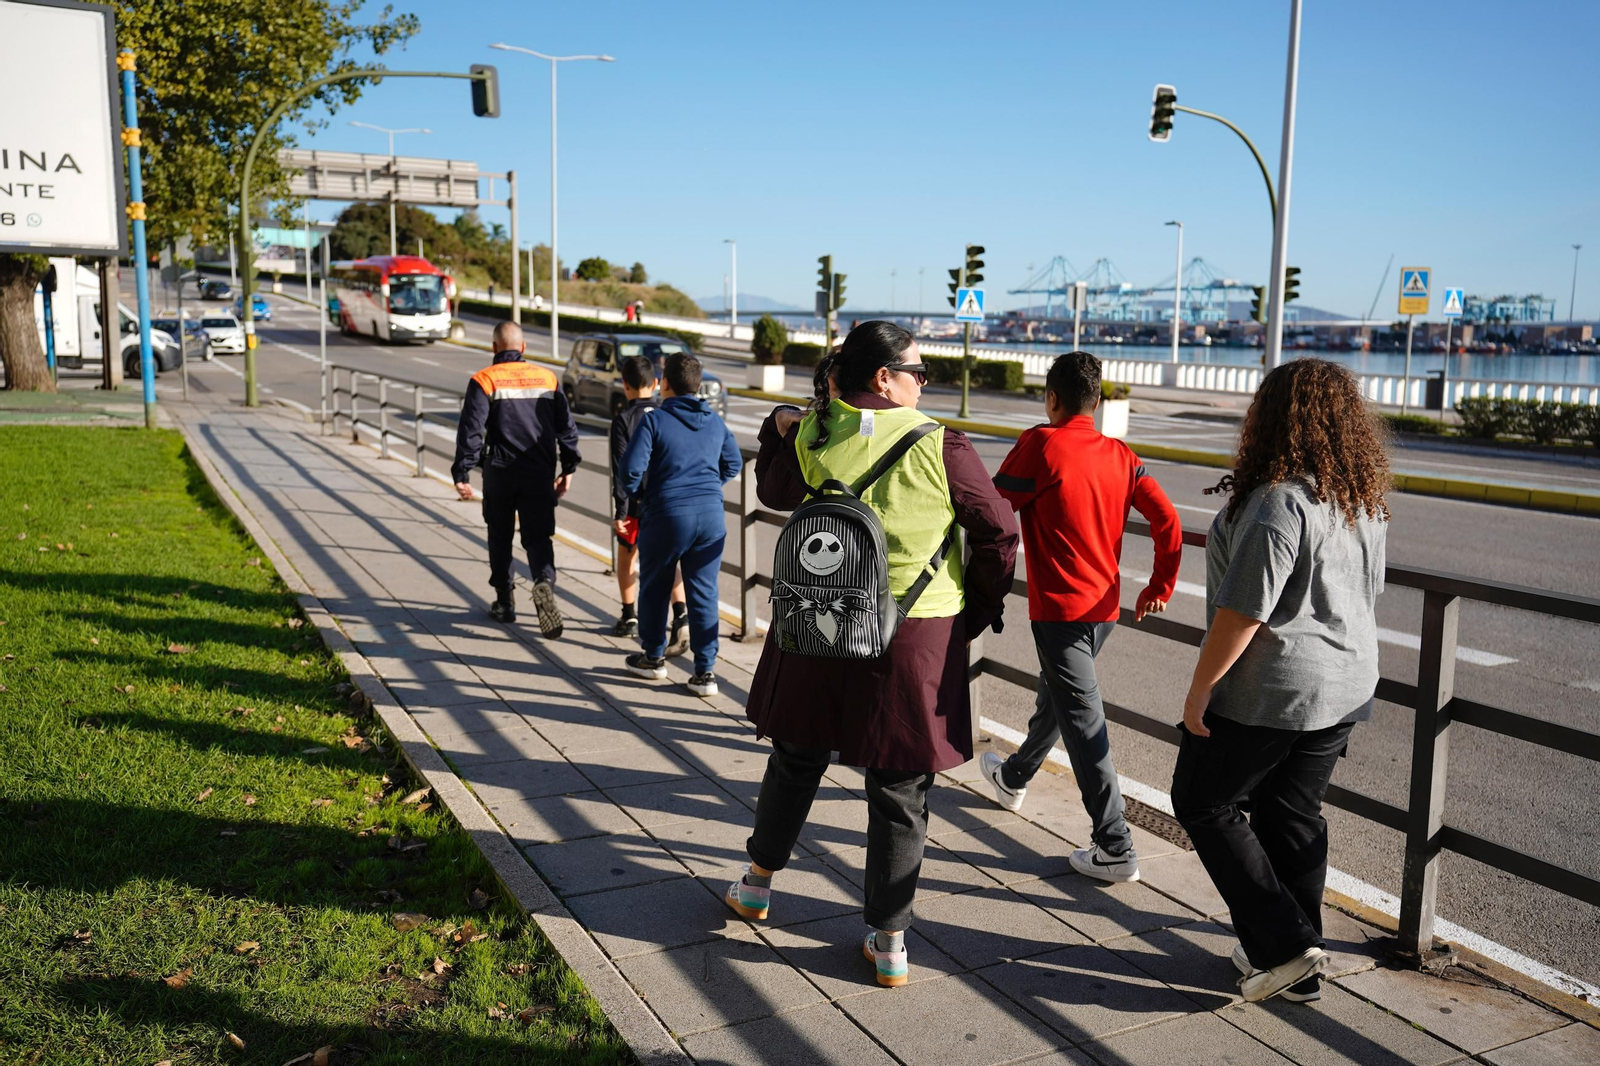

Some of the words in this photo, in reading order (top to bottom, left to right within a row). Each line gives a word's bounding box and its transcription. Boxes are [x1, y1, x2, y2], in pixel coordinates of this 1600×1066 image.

[2, 149, 83, 174] INA
[0, 183, 55, 199] NTE
[0, 212, 16, 226] 6
